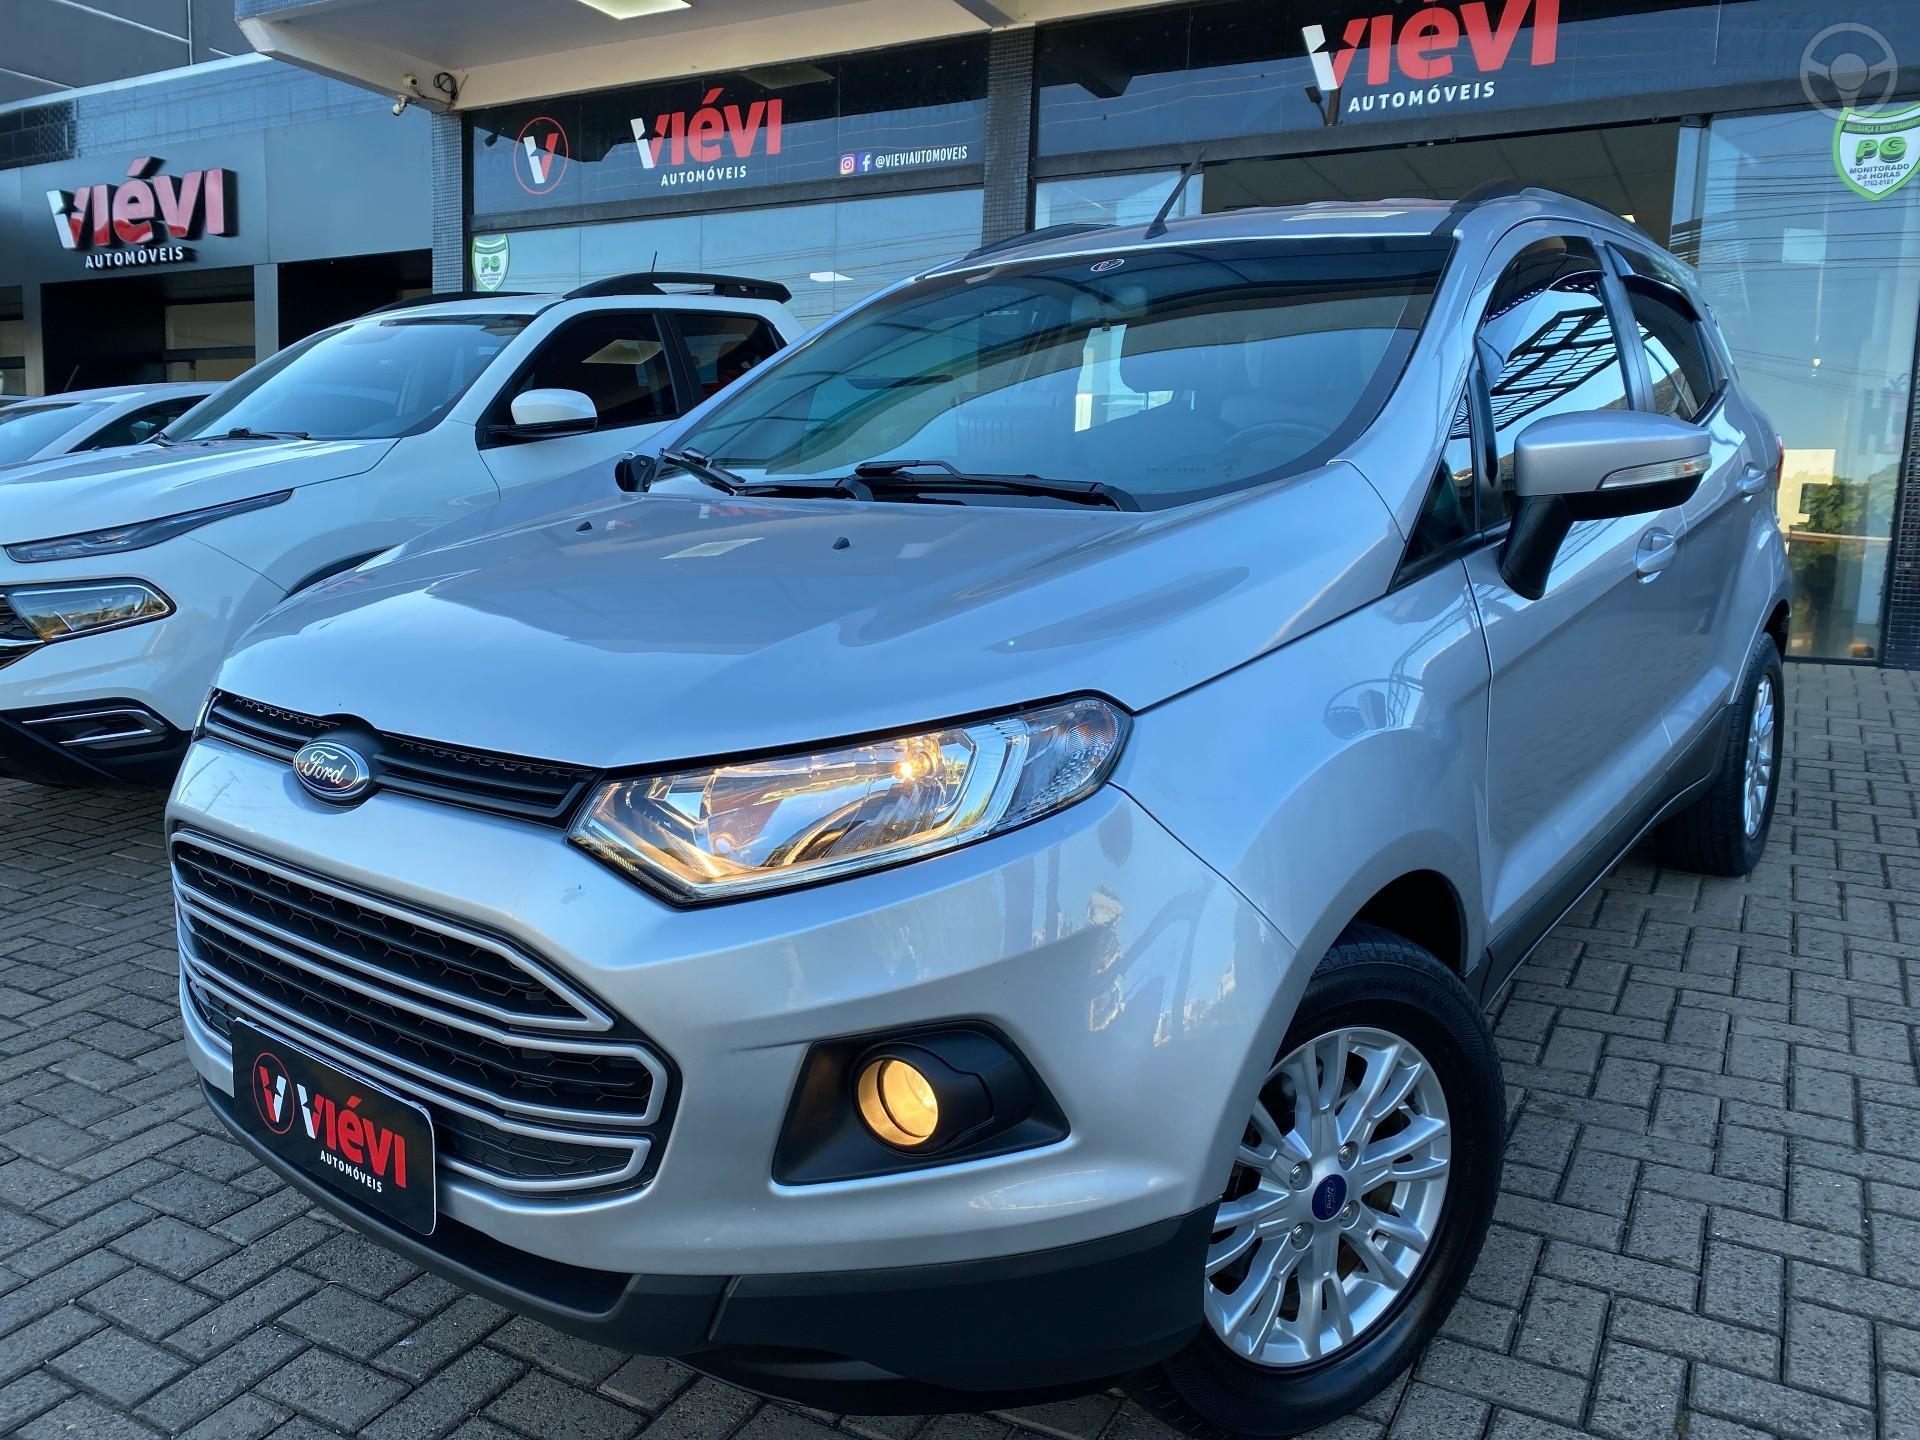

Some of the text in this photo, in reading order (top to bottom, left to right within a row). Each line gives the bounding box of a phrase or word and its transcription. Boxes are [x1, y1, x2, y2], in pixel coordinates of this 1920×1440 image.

[1348, 81, 1496, 112] AUTOMÓVEIS
[875, 145, 968, 168] @VIEVIAUTOMOVEIS
[661, 165, 747, 186] AUTOMÓVEIS
[1849, 163, 1910, 174] MONITORADO
[1870, 171, 1901, 180] HORAS
[85, 245, 184, 269] AUTOMÓVEIS
[303, 750, 347, 784] Ford
[320, 1150, 384, 1193] AUTOMÓVEIS
